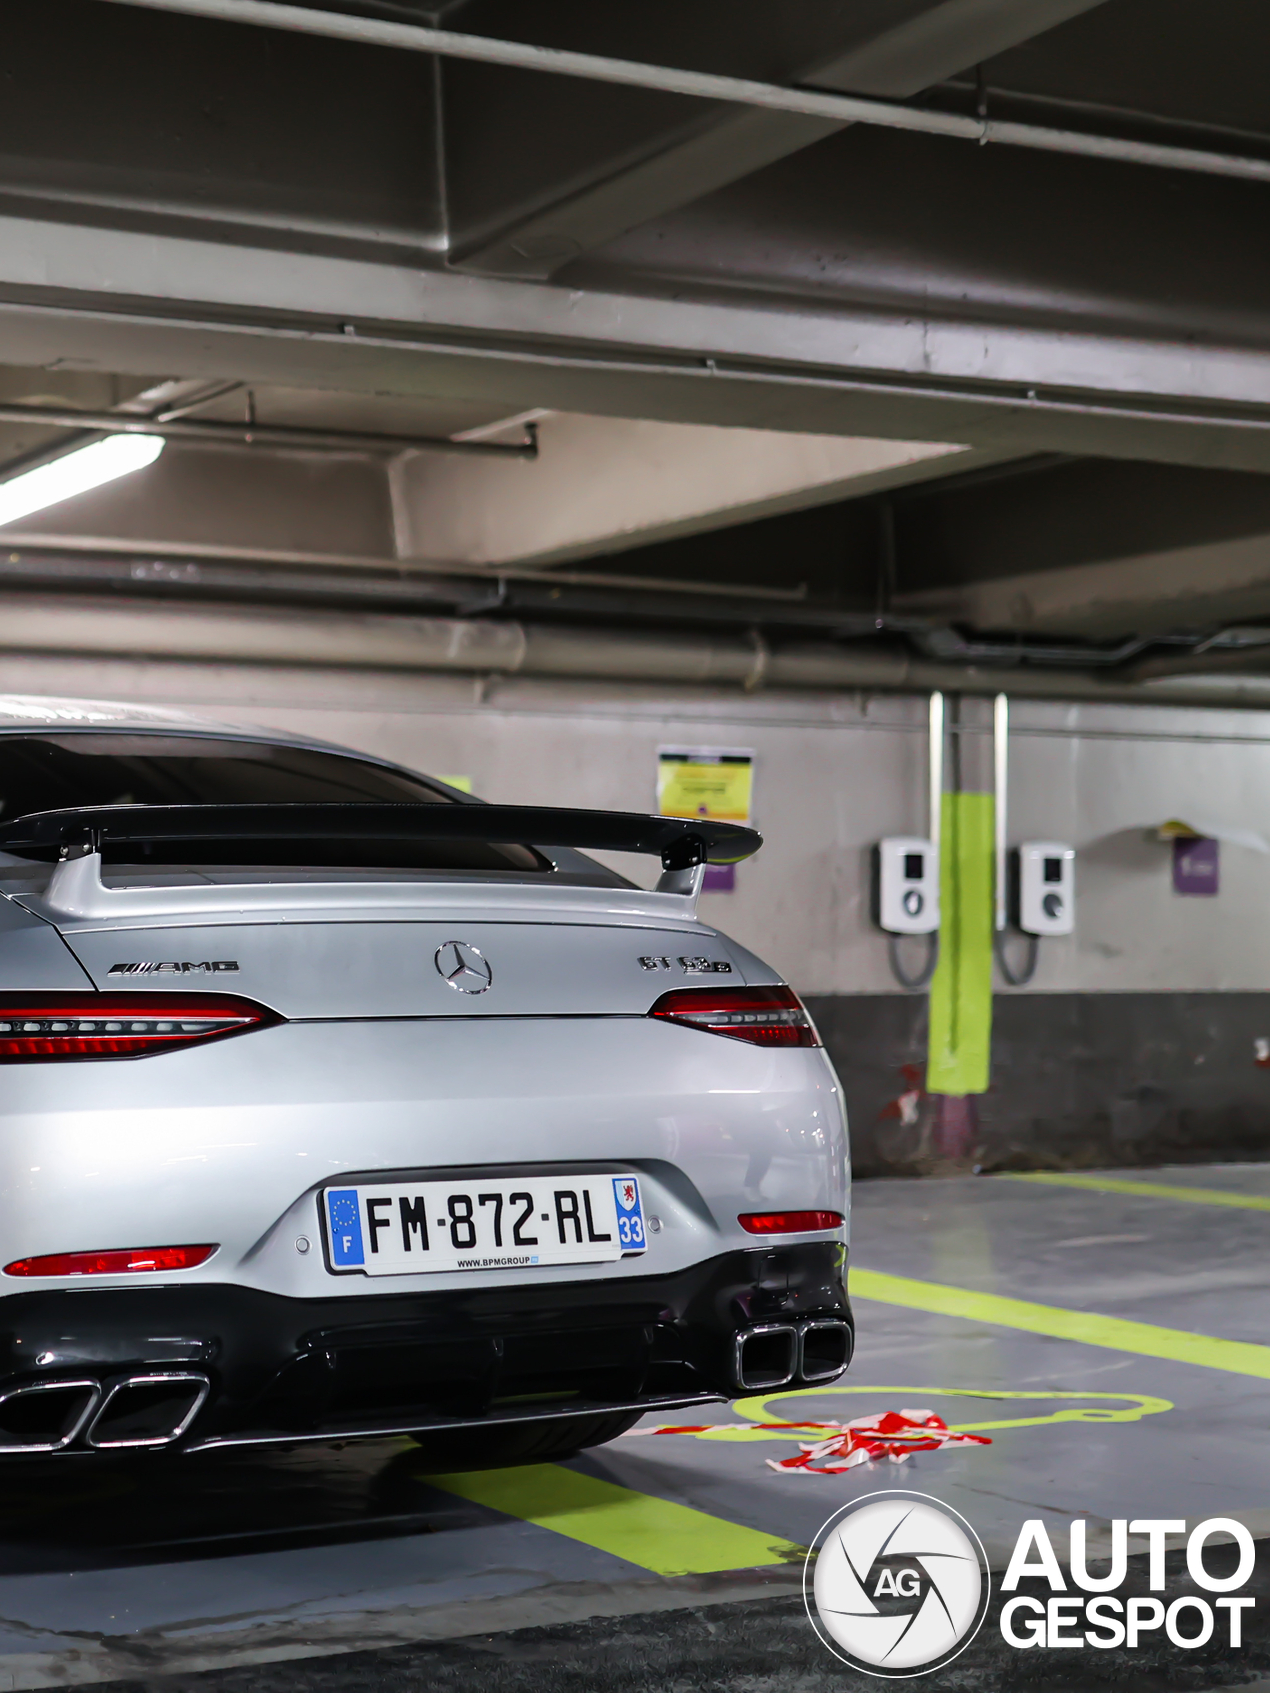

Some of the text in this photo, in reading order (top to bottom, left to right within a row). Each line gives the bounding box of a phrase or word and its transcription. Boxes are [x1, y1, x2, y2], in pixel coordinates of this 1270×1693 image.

[637, 956, 672, 972] GT
[618, 1216, 644, 1243] 33
[342, 1235, 352, 1254] F
